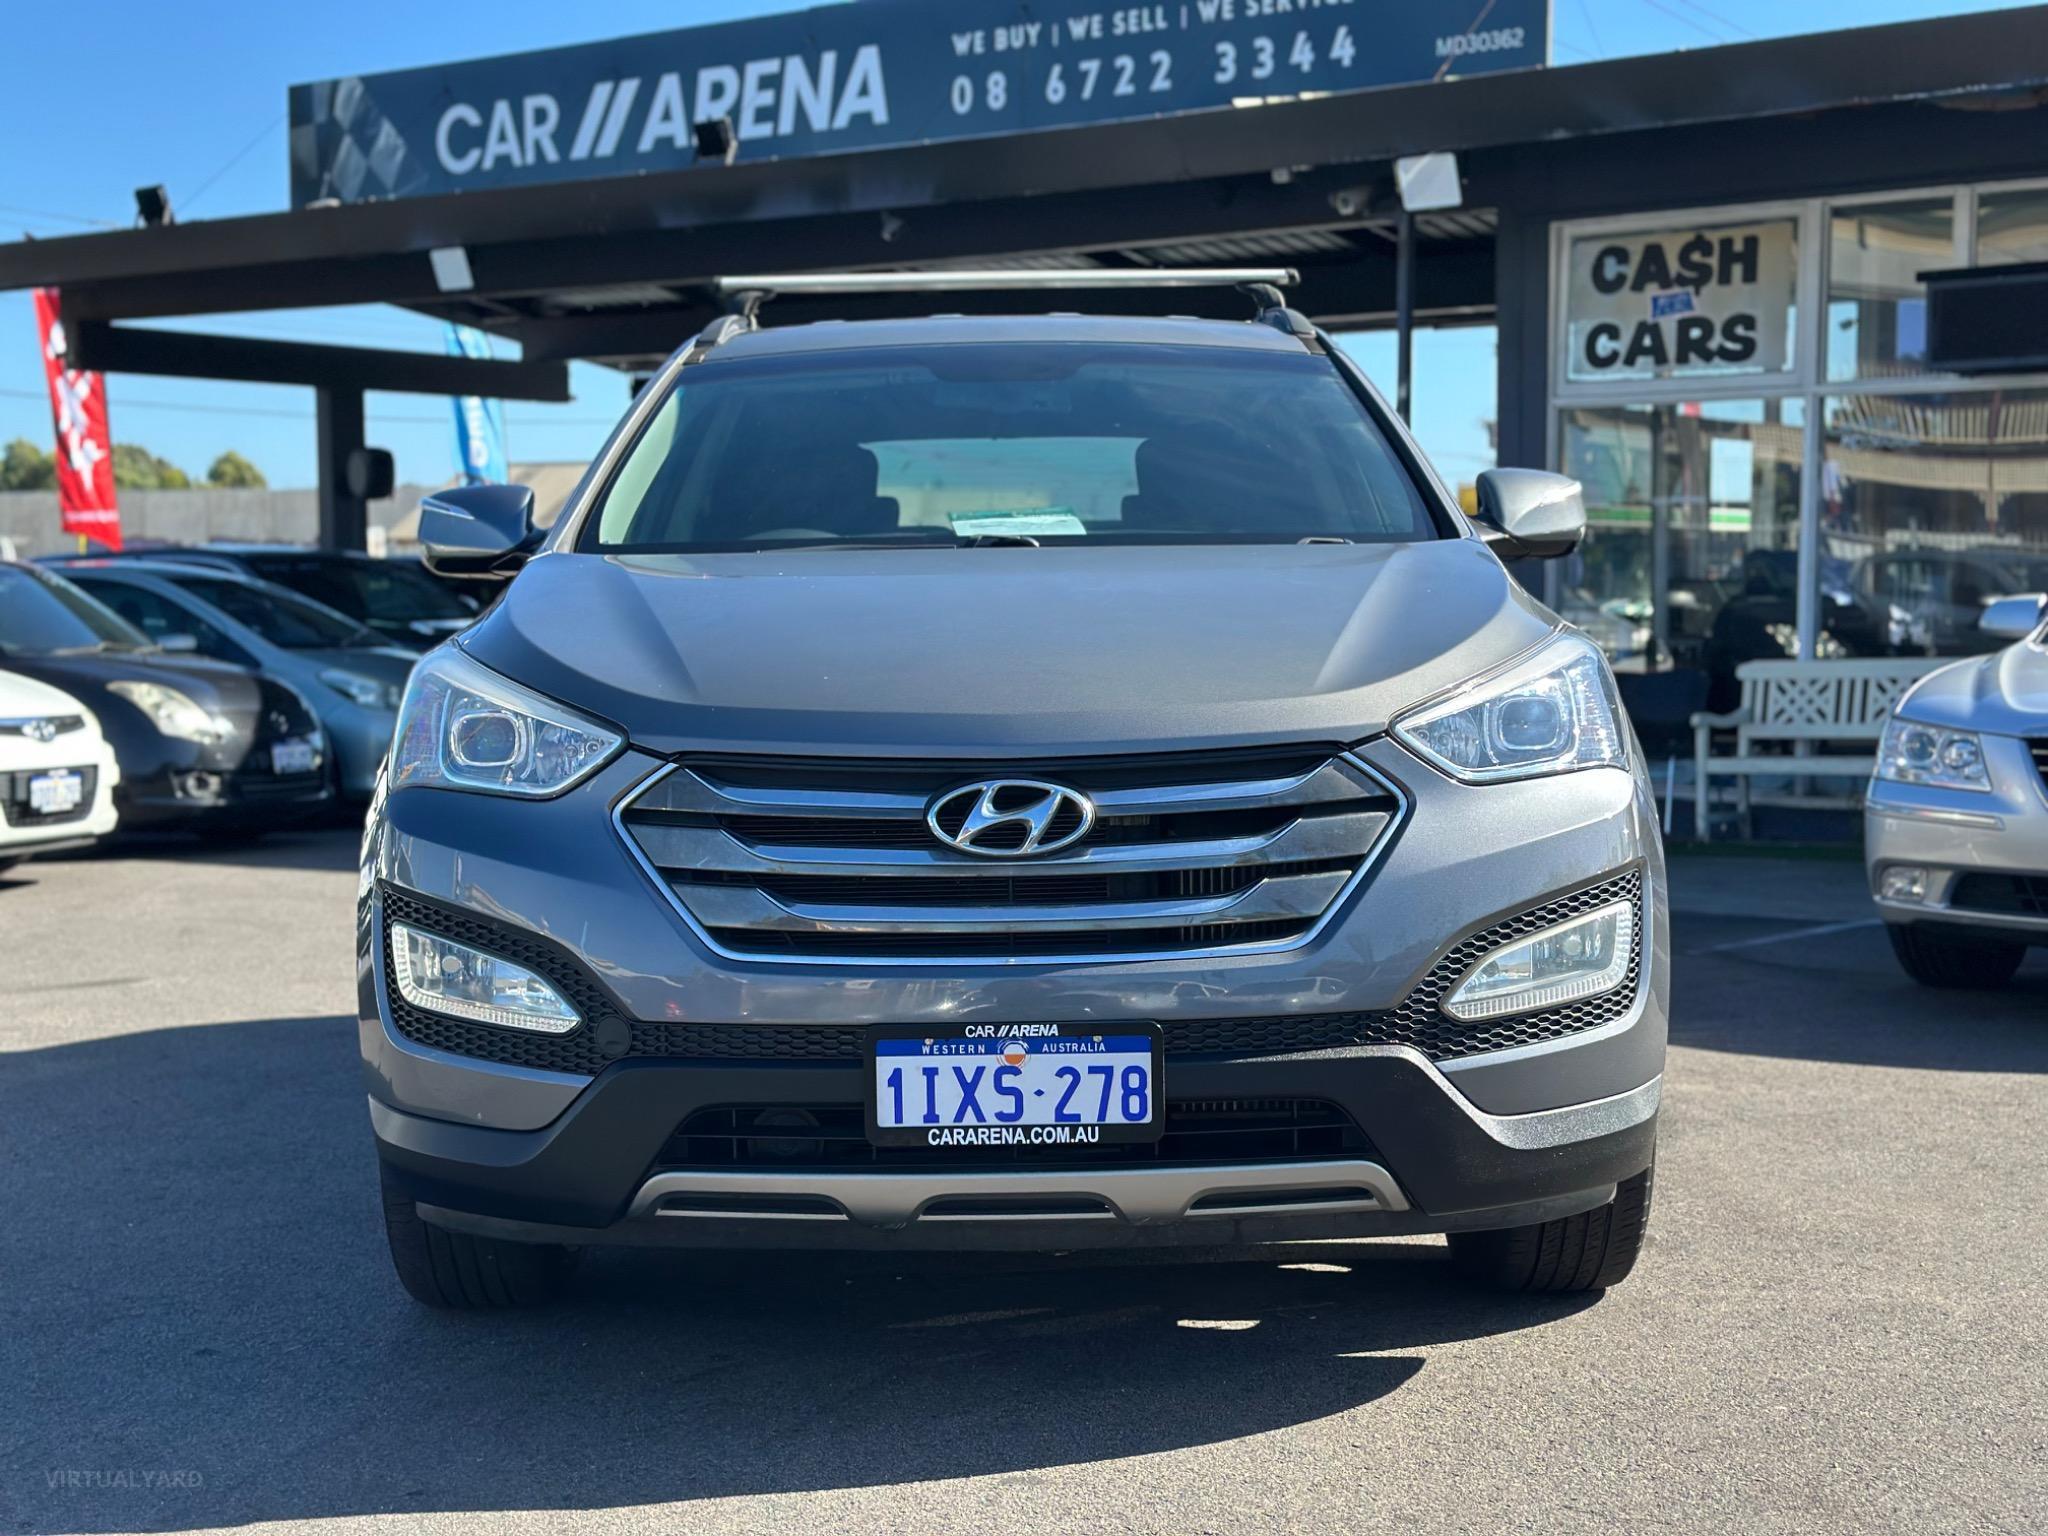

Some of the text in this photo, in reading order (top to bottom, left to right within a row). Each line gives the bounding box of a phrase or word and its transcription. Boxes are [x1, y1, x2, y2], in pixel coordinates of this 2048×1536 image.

[951, 30, 985, 56] WE
[993, 23, 1041, 52] BUY
[1067, 14, 1103, 40] WE
[1112, 5, 1168, 36] SELL
[951, 25, 1356, 115] 08 6722 3344
[1585, 312, 1757, 369] CARS
[921, 1042, 1106, 1055] WESTERN AUSTRALIA
[927, 1126, 1099, 1145] CARARENA.COM.AU
